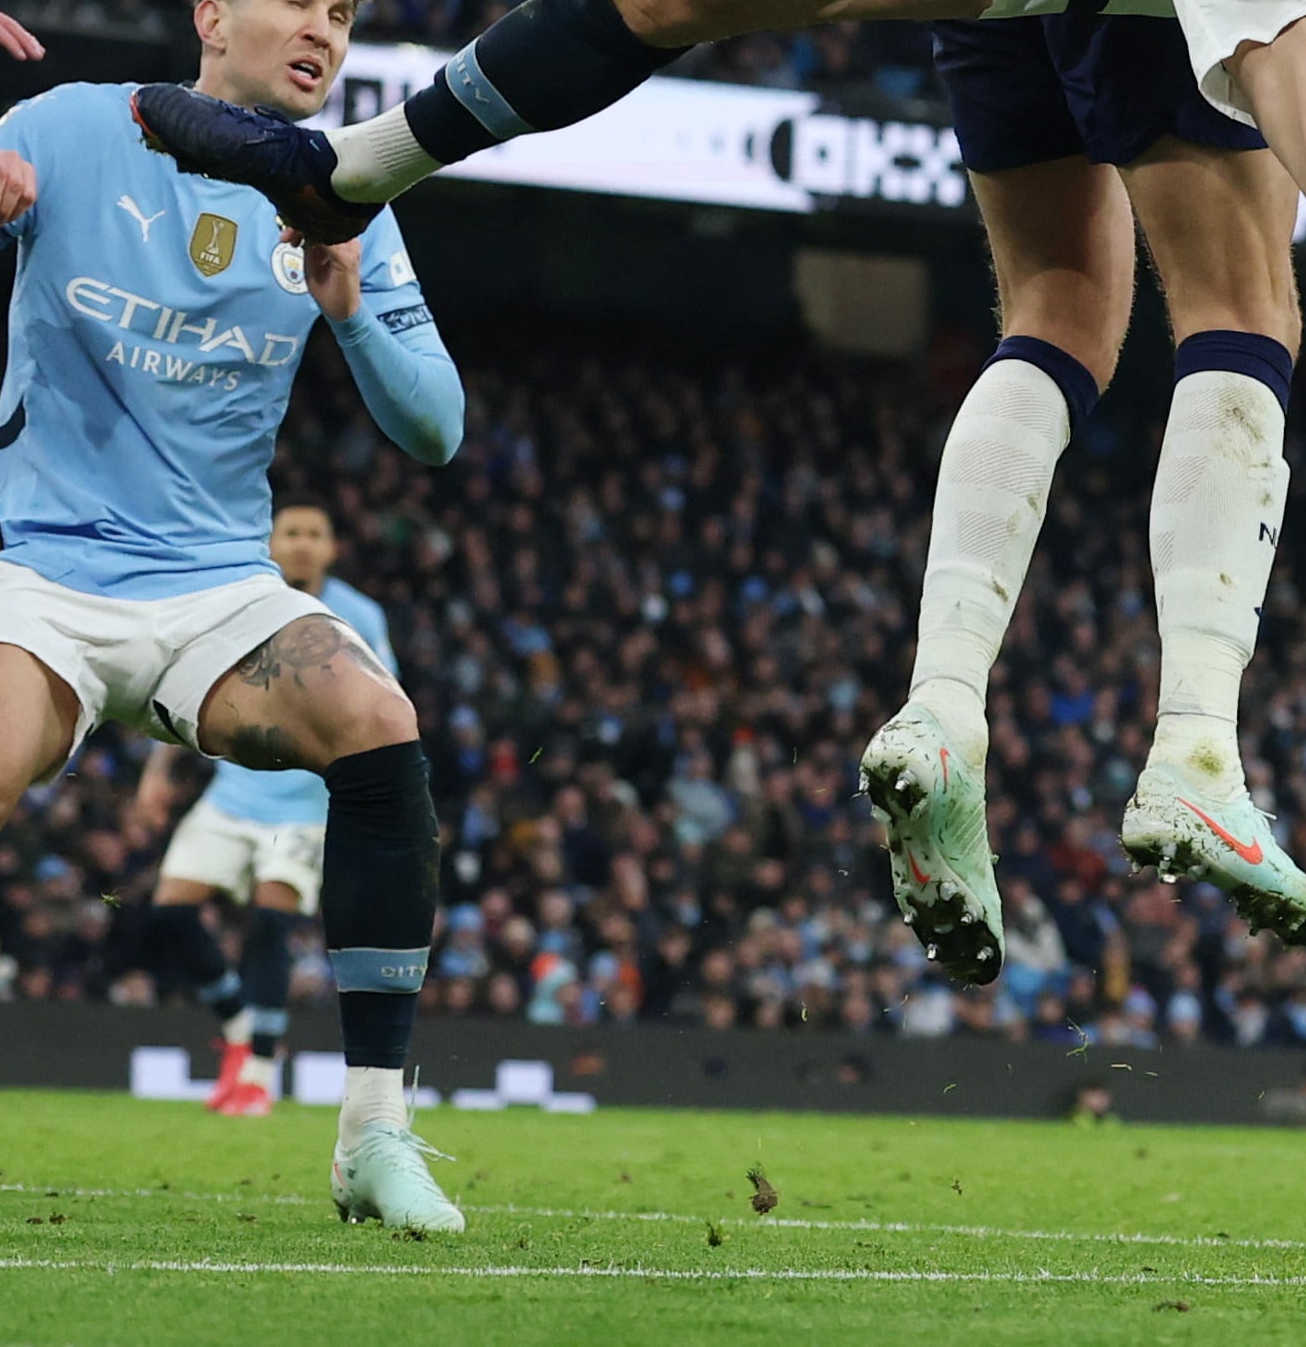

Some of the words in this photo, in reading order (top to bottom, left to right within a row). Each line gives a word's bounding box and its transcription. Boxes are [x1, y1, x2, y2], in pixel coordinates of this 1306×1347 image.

[199, 251, 222, 266] FIFA
[66, 277, 298, 367] ETIHAD
[106, 341, 241, 392] AIRWAYS
